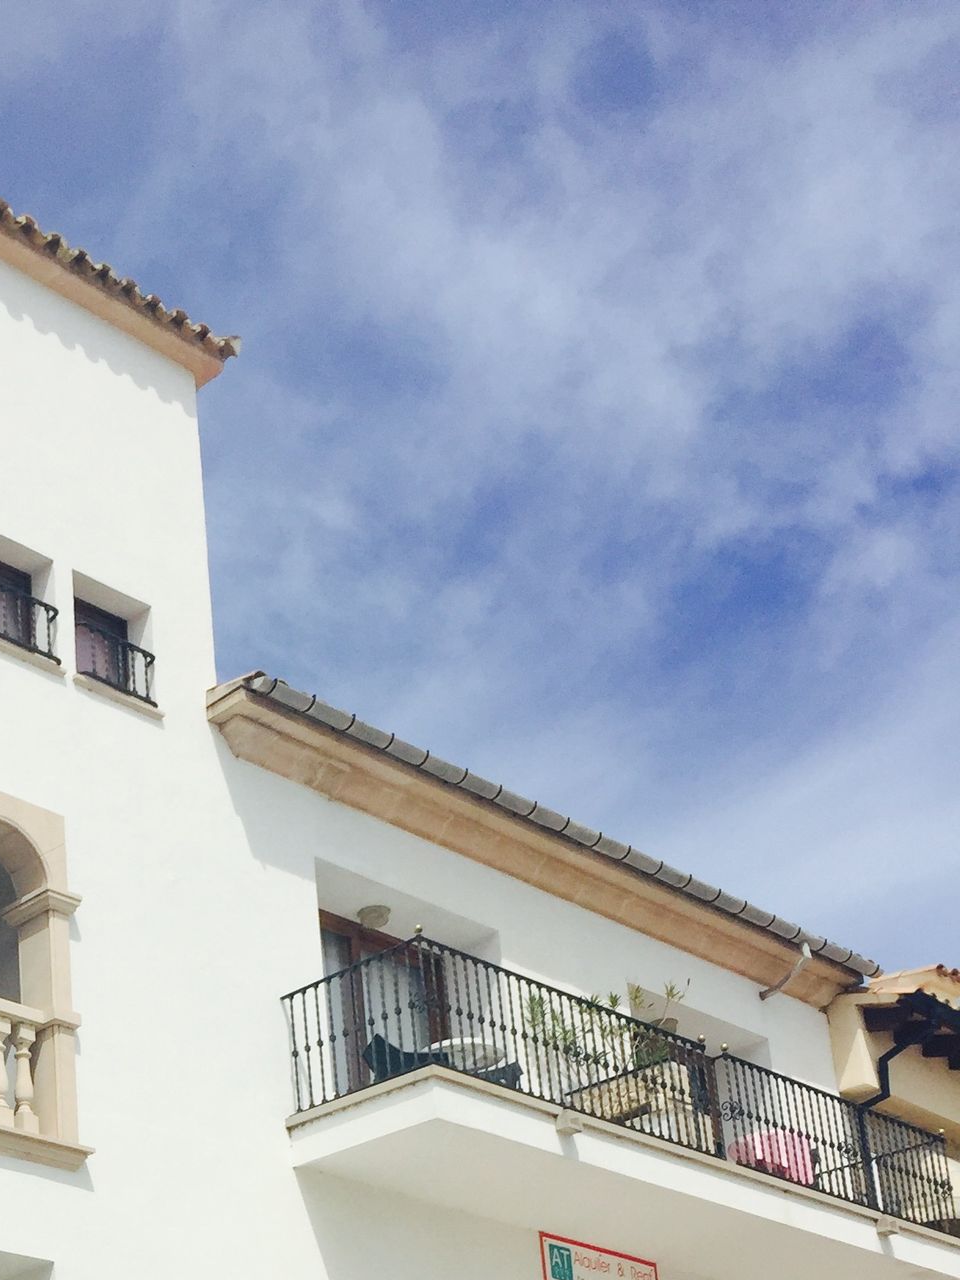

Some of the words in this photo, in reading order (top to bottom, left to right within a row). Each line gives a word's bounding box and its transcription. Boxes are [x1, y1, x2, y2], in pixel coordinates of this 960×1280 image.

[551, 1248, 570, 1270] AT
[574, 1251, 610, 1273] Alquiler
[617, 1263, 624, 1277] &
